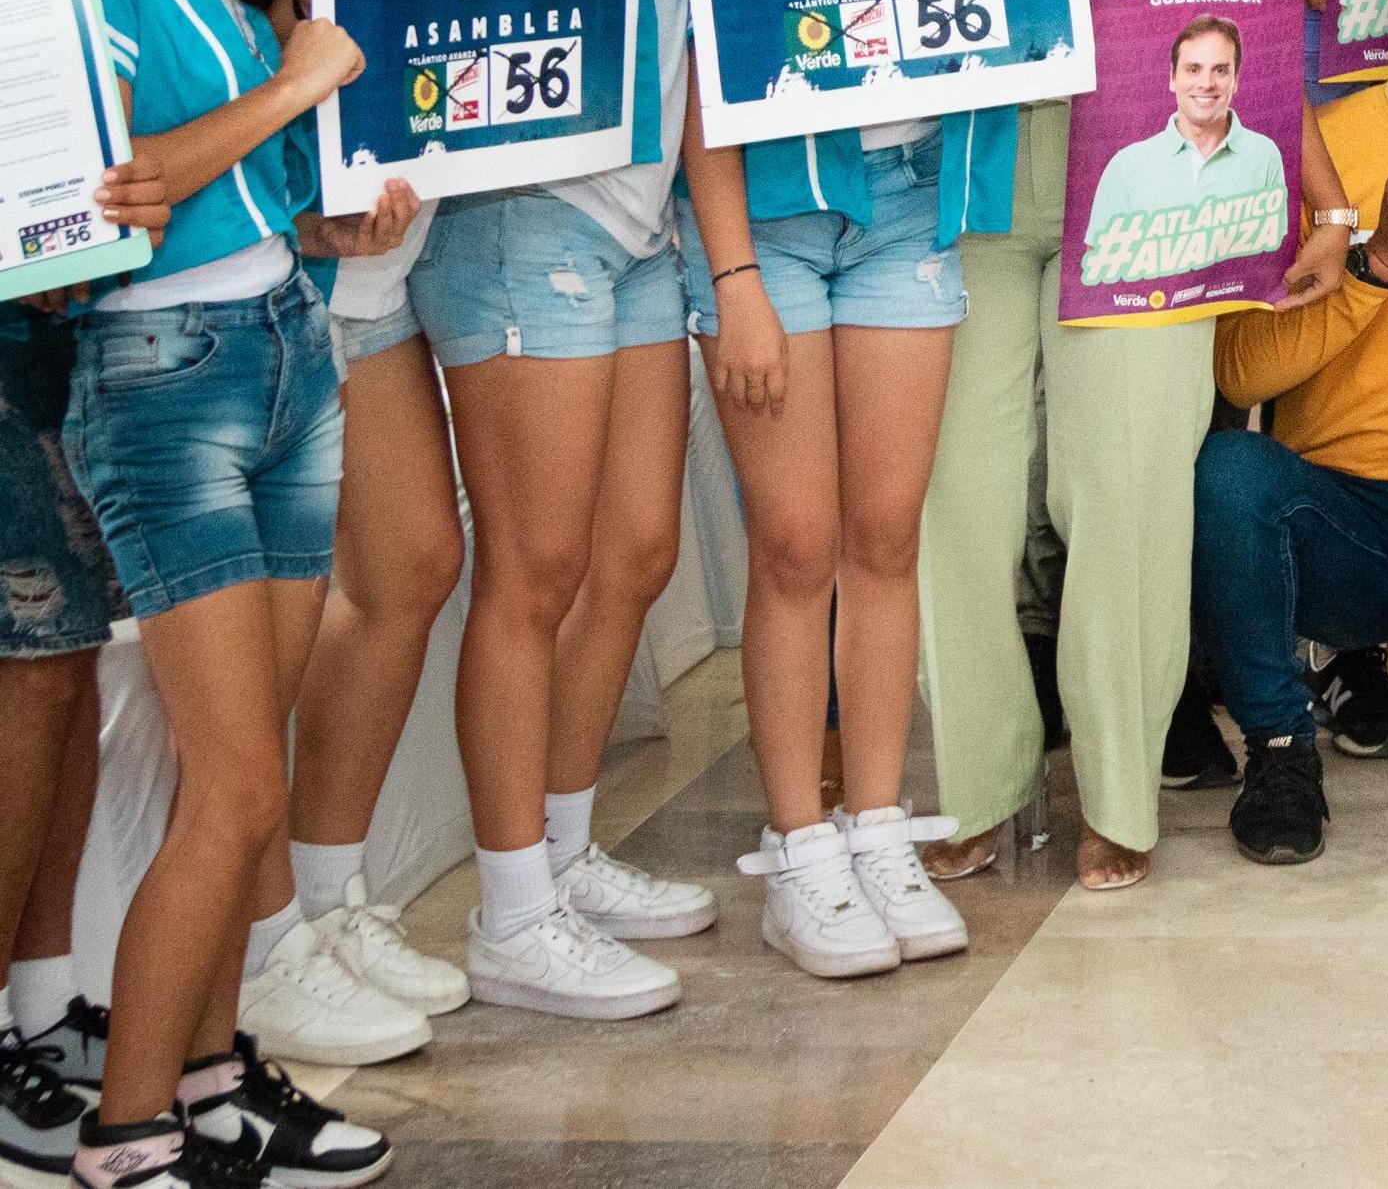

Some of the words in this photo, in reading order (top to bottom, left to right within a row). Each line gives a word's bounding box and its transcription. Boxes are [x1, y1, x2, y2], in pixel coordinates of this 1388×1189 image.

[405, 8, 582, 48] ASAMBLEA
[795, 51, 841, 71] Verde
[506, 47, 570, 114] 56
[409, 114, 444, 134] Verde
[65, 225, 91, 246] 56
[1128, 214, 1282, 277] AVANZA
[1113, 294, 1147, 307] Verde
